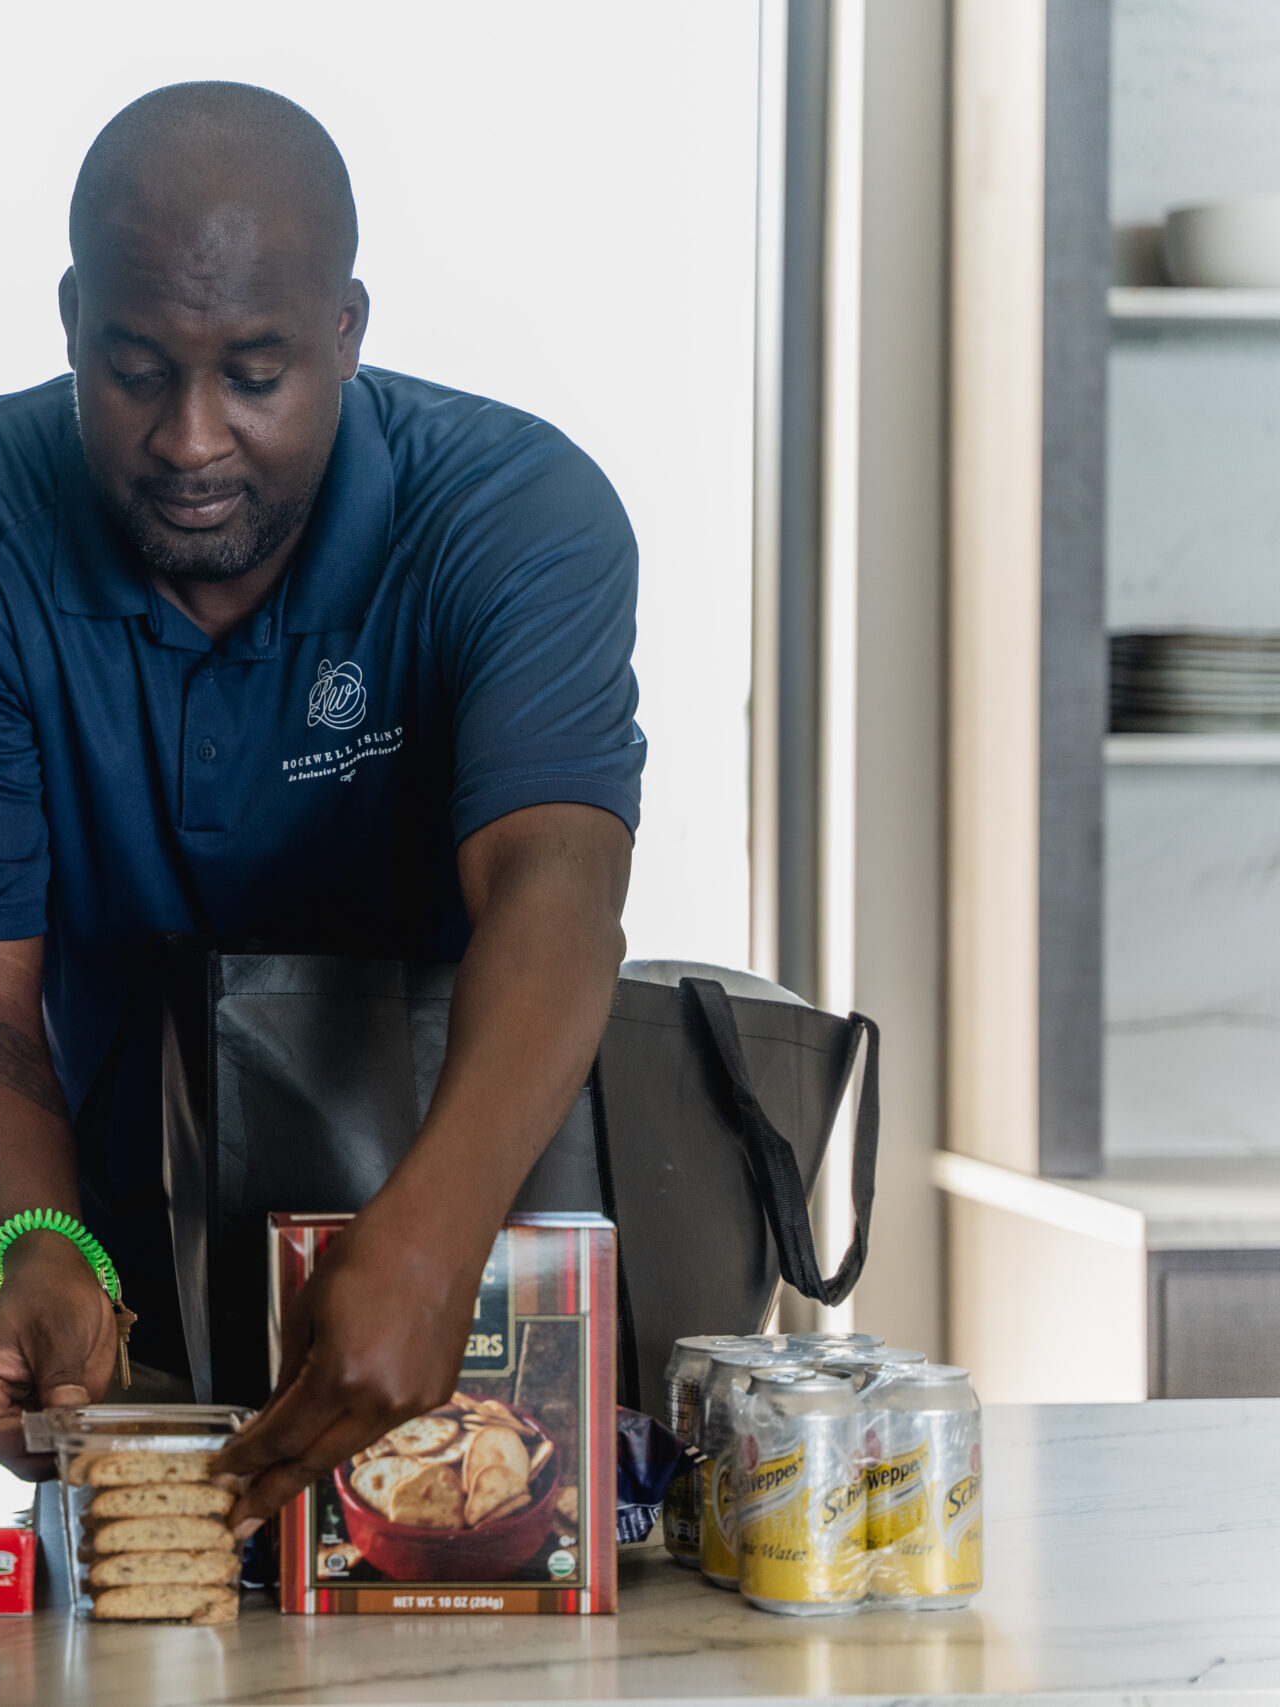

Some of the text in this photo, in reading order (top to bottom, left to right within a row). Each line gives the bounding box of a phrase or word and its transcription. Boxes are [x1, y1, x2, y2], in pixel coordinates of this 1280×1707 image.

[282, 745, 353, 771] ROCKWELL
[761, 1542, 808, 1561] Water
[393, 1596, 504, 1610] NET WT. 10 OZ (284g)
